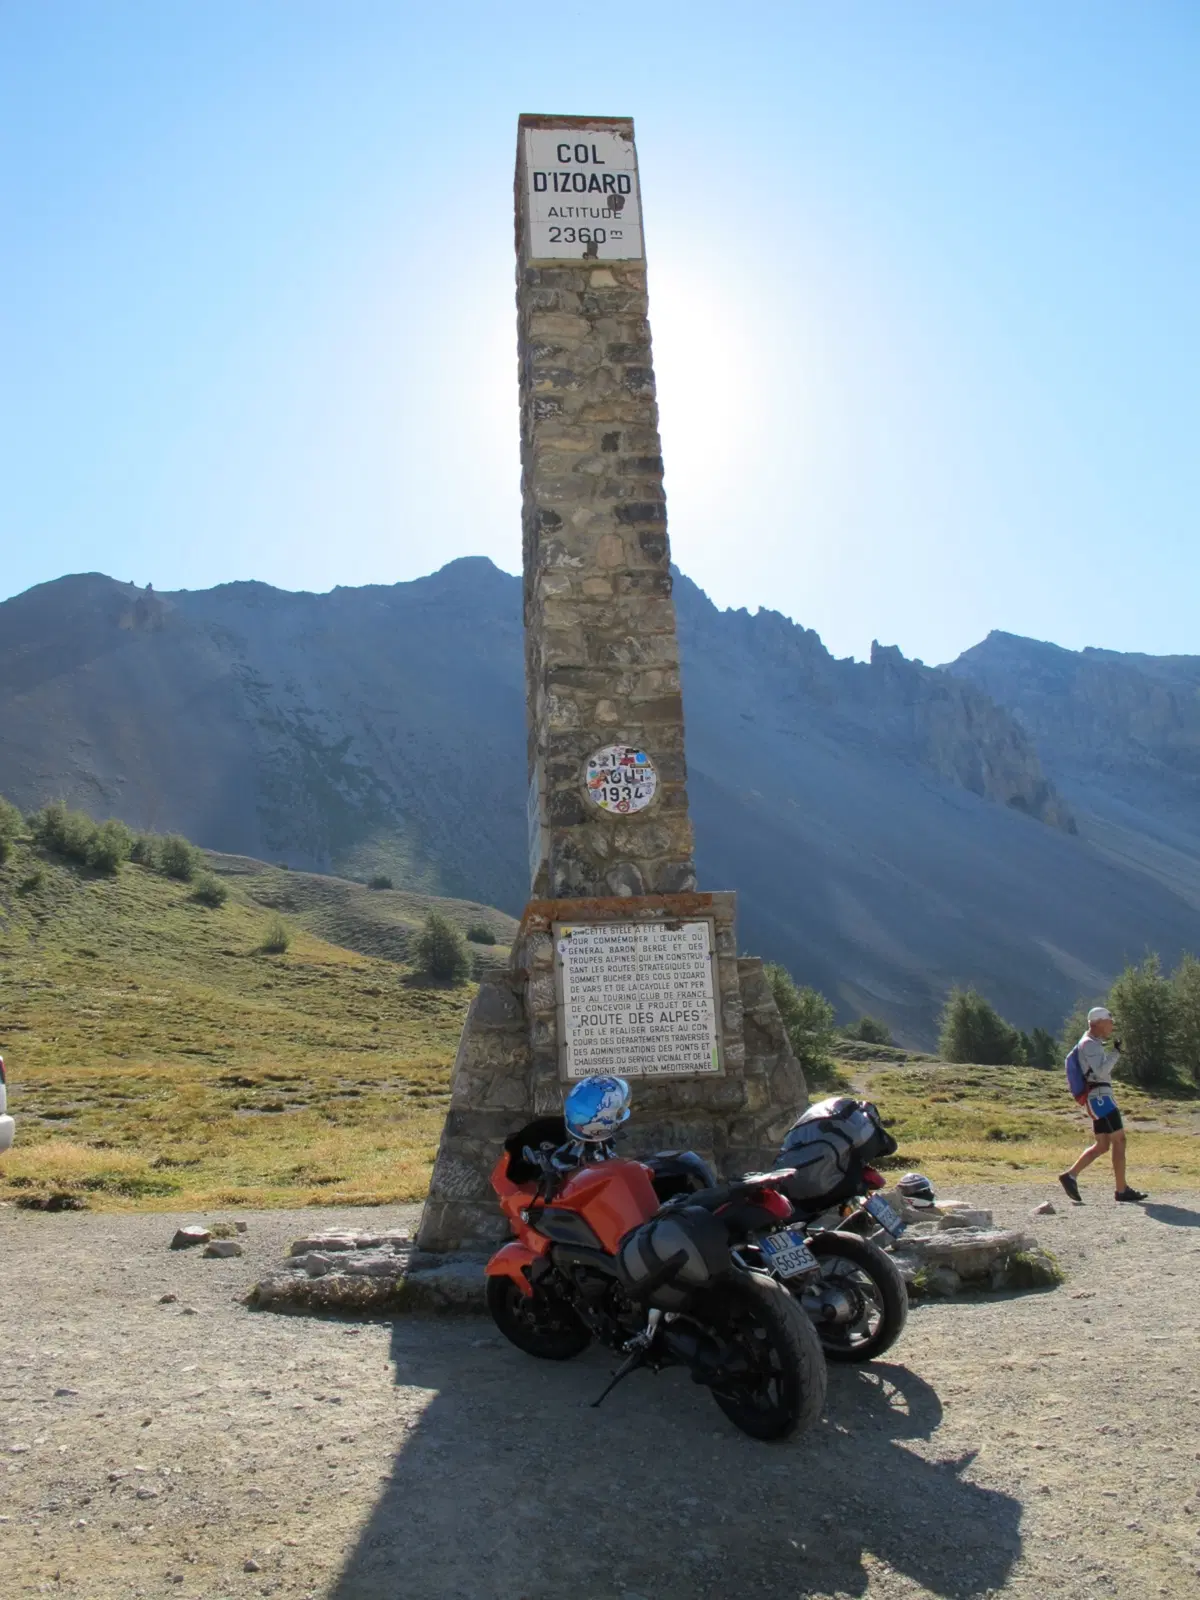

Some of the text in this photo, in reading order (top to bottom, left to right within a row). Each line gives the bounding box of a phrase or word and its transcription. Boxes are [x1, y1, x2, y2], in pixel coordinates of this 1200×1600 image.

[557, 144, 605, 164] COL
[533, 172, 631, 194] D'IZOARD
[548, 206, 622, 219] ALTITUDE
[548, 227, 606, 243] 2360
[602, 787, 645, 801] 1934
[643, 944, 667, 953] BERGE
[569, 957, 603, 965] TROUPES
[606, 955, 636, 963] ALPINES
[639, 982, 670, 990] CAYOLLE
[603, 993, 636, 1001] TOURING
[640, 992, 660, 1000] CLUB
[663, 991, 674, 999] DE
[677, 990, 707, 998] FRANCE
[585, 1003, 631, 1012] CONCEVOIR
[648, 1001, 679, 1009] PROJET
[682, 1000, 692, 1008] DE
[629, 1012, 654, 1024] DES
[691, 1023, 708, 1031] CON
[573, 1038, 598, 1046] COURS
[600, 1037, 615, 1045] DES
[573, 1042, 710, 1056] DES ADMINISTRATIONS DES PONTS ET
[616, 1056, 626, 1064] DU
[627, 1055, 655, 1063] SERVICE
[683, 1053, 691, 1061] ET
[693, 1052, 701, 1060] DE
[575, 1067, 616, 1075] COMPAGNIE
[618, 1066, 639, 1074] PARIS
[768, 1234, 788, 1250] DJ
[776, 1247, 813, 1271] 56955
